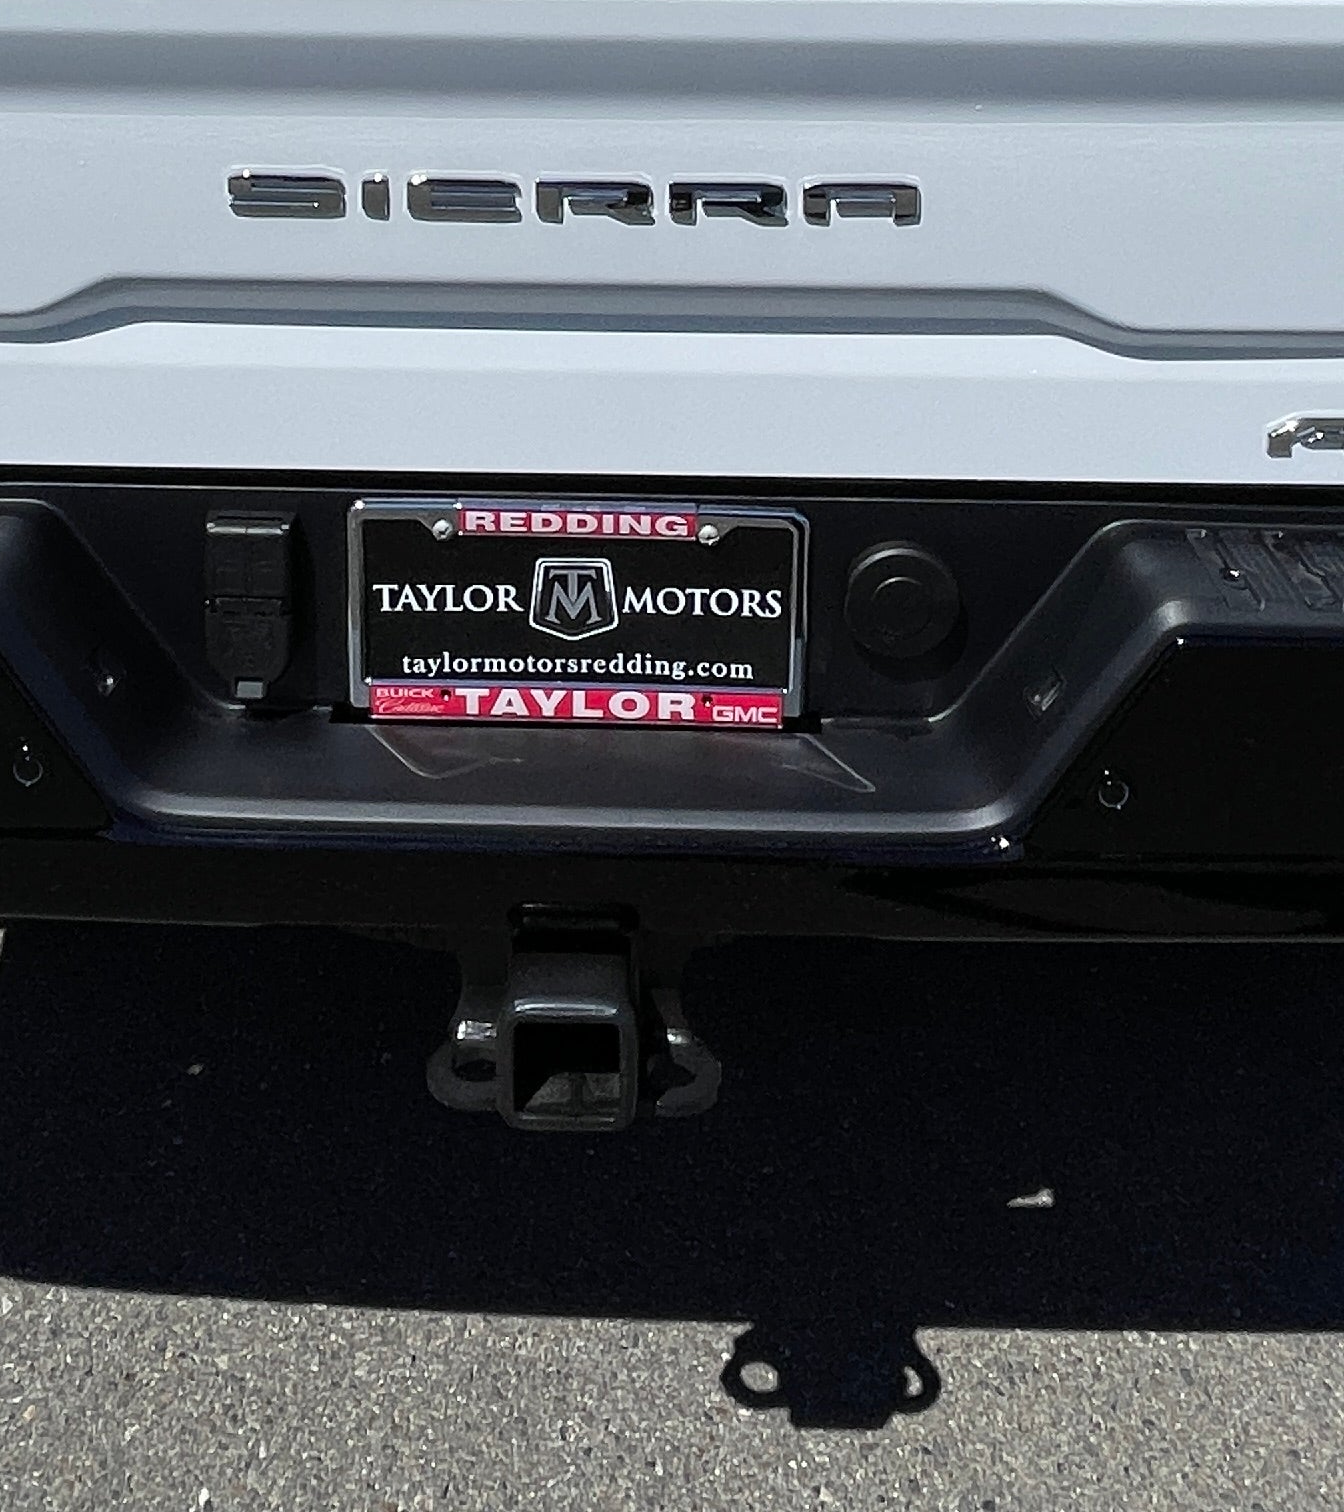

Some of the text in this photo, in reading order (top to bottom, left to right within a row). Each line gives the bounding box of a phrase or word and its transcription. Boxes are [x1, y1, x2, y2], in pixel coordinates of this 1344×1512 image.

[227, 168, 922, 227] SIERRA
[464, 510, 689, 537] REDDING
[372, 583, 525, 613] TAYLOR
[622, 586, 782, 619] MOTORS
[402, 651, 754, 681] taylormotorsredding.com
[376, 688, 435, 699] BUICK
[454, 687, 696, 722] TAYLOR
[712, 705, 778, 724] GMC
